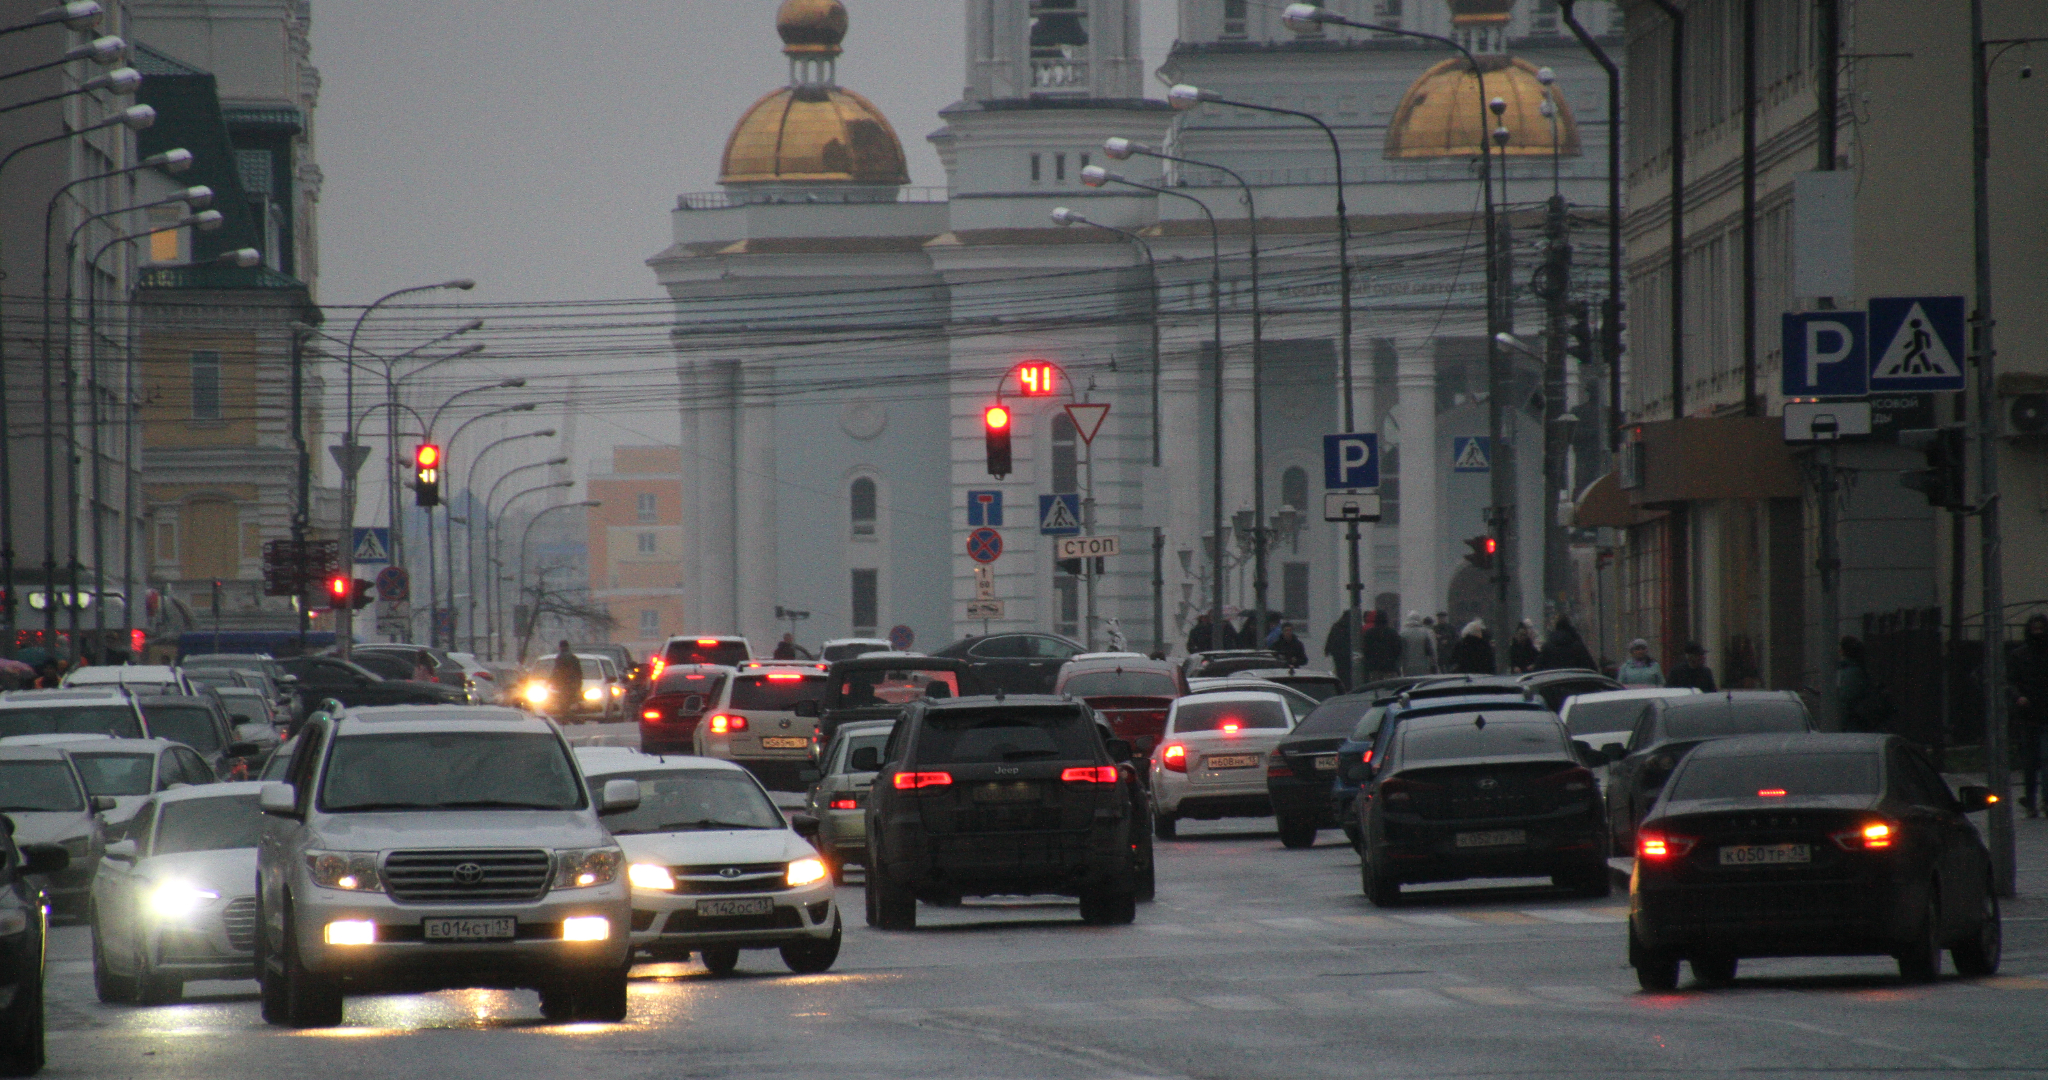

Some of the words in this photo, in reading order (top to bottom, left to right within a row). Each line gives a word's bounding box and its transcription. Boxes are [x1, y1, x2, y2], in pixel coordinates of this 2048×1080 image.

[1805, 321, 1854, 386] P
[1020, 366, 1050, 392] 41
[1339, 439, 1370, 483] P
[1065, 538, 1114, 555] СТОП
[994, 766, 1019, 775] Jeep
[1725, 847, 1786, 863] К050ТР
[702, 901, 753, 915] К142ОС
[758, 899, 769, 910] 13
[430, 920, 490, 936] Е014СТ
[495, 918, 510, 931] 13
